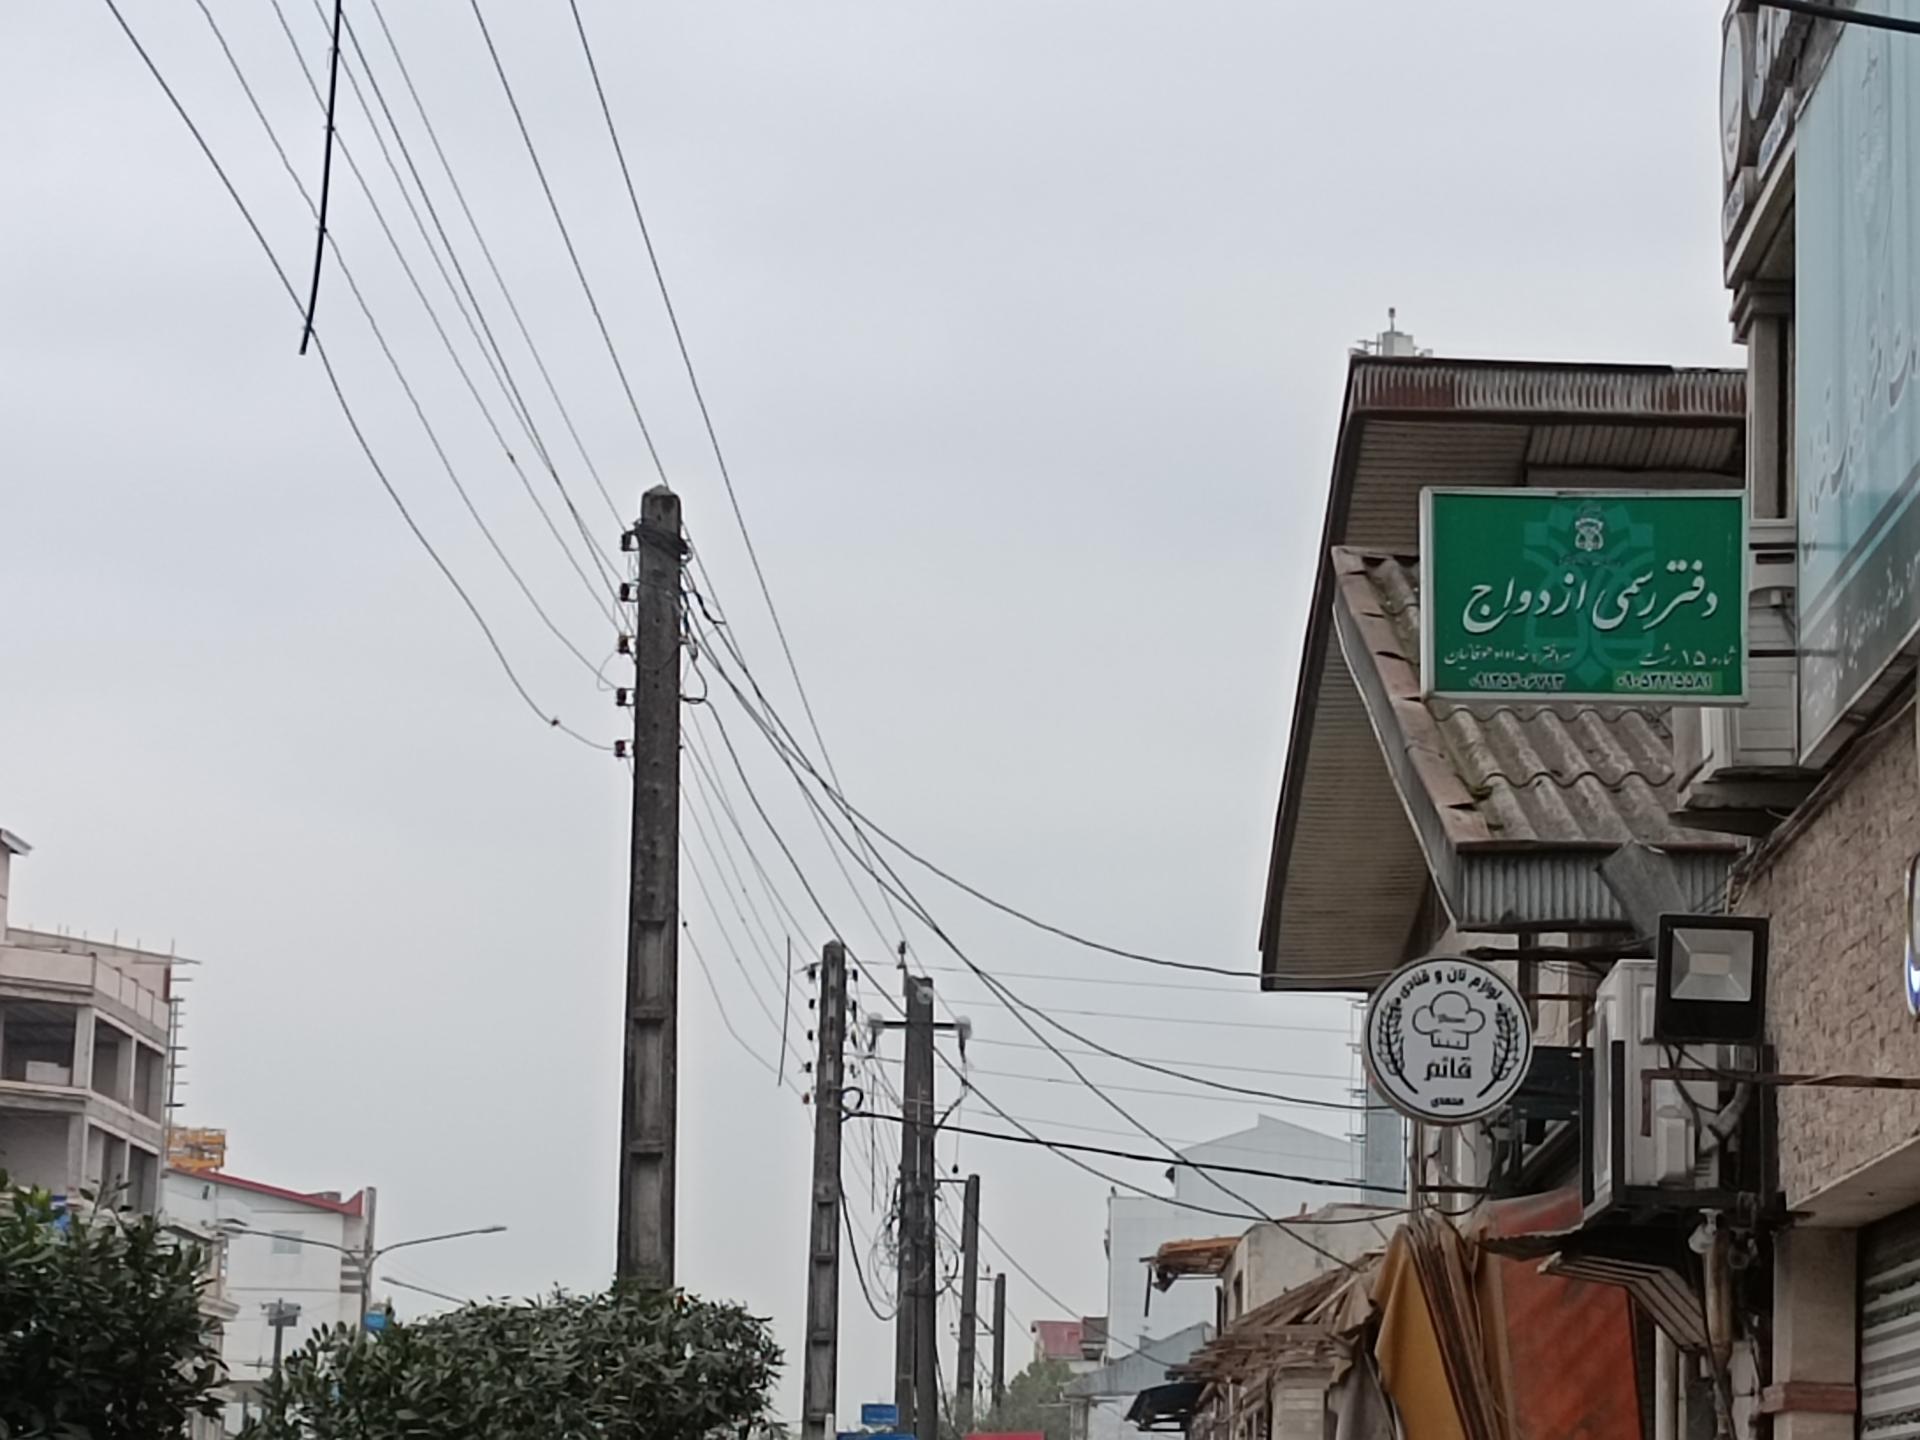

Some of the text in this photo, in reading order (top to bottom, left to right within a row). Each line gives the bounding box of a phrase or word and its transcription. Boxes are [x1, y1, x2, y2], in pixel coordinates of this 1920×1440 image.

[1463, 559, 1718, 633] دفتر رسمی ازدواج
[1639, 643, 1678, 666] رشت
[1682, 650, 1706, 666] ۱۵
[1401, 967, 1503, 1000] لوازم نان و قنادی
[1424, 1056, 1472, 1081] قائم
[1430, 1097, 1464, 1108] محمدی
